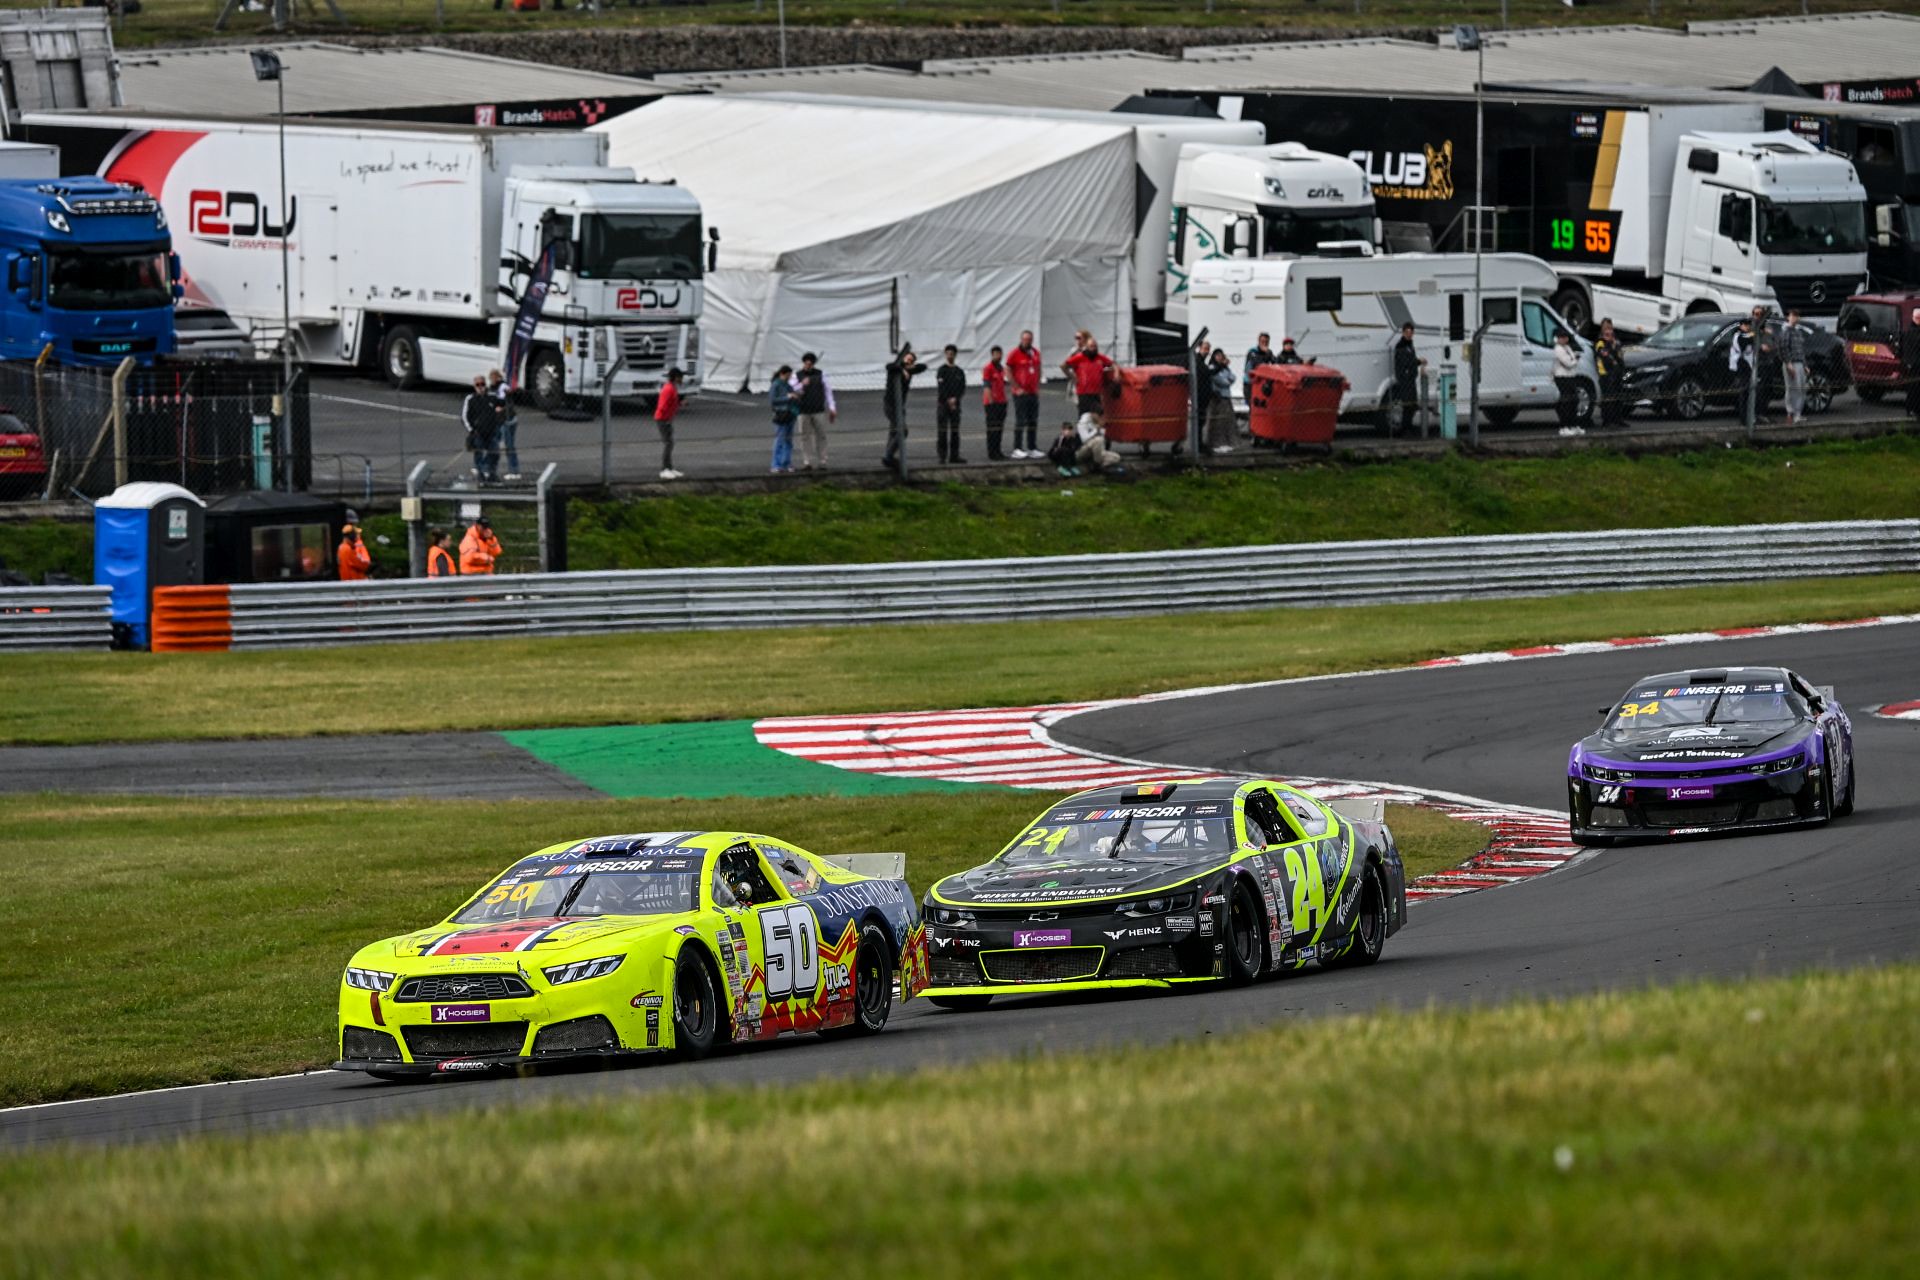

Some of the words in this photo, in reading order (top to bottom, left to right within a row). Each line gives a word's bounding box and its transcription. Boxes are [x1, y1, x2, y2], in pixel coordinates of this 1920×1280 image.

[503, 109, 577, 124] BrandsHatch
[357, 150, 395, 185] speed
[400, 160, 418, 172] we
[1371, 186, 1451, 199] OMPETITION
[1551, 219, 1575, 249] 19
[1585, 220, 1611, 252] 55
[101, 343, 132, 352] DAF
[1684, 685, 1747, 696] NASCAR
[1619, 701, 1660, 717] 34
[1686, 750, 1744, 759] Technology
[1598, 786, 1622, 803] 34
[1109, 806, 1187, 819] NASCAR
[1020, 826, 1071, 854] 24
[573, 860, 653, 874] NASCAR
[484, 884, 535, 904] 50
[1284, 843, 1326, 934] 24
[816, 884, 871, 918] SUNSET
[868, 880, 904, 905] IMMO
[972, 892, 1017, 900] DRIVEN
[1200, 913, 1213, 922] WRK
[1128, 927, 1162, 936] HEINZ
[1200, 922, 1213, 931] MKT
[757, 902, 819, 1002] 50
[633, 996, 663, 1006] KENNOL
[448, 1009, 486, 1017] HOOSIER
